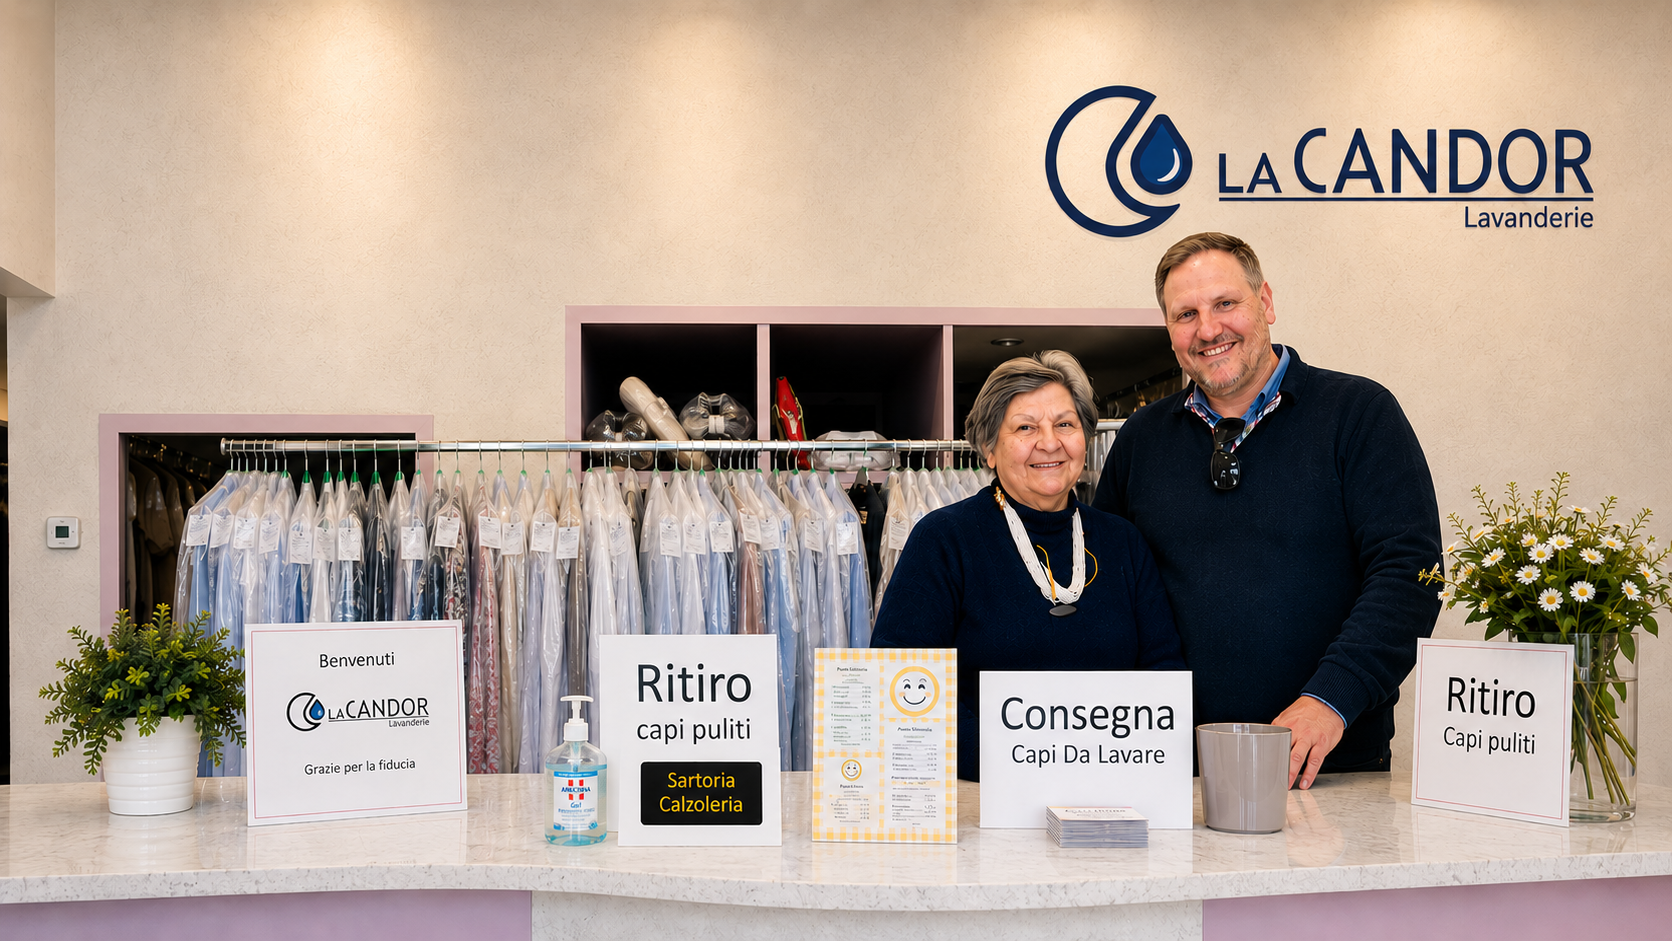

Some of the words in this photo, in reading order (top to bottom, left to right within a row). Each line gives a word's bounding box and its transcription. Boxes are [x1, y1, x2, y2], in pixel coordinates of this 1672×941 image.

[1218, 152, 1282, 194] LA
[1293, 127, 1594, 194] CANDOR
[1464, 205, 1594, 228] Lavanderie
[319, 651, 395, 668] Benvenuti
[638, 663, 752, 703] Ritiro
[1447, 676, 1536, 719] Ritiro
[388, 718, 430, 728] Lavanderie
[1001, 697, 1175, 739] Consegna
[637, 718, 684, 745] capi
[693, 717, 751, 745] puliti
[1443, 726, 1482, 752] Capi
[1488, 731, 1536, 755] puliti
[304, 763, 341, 776] Grazie
[344, 763, 363, 775] per
[366, 760, 376, 772] la
[379, 758, 416, 771] fiducia
[1012, 744, 1056, 768] Capi
[1064, 744, 1090, 764] Da
[1098, 744, 1165, 764] Lavare
[667, 771, 736, 789] Sartoria
[659, 795, 743, 813] Calzoleria
